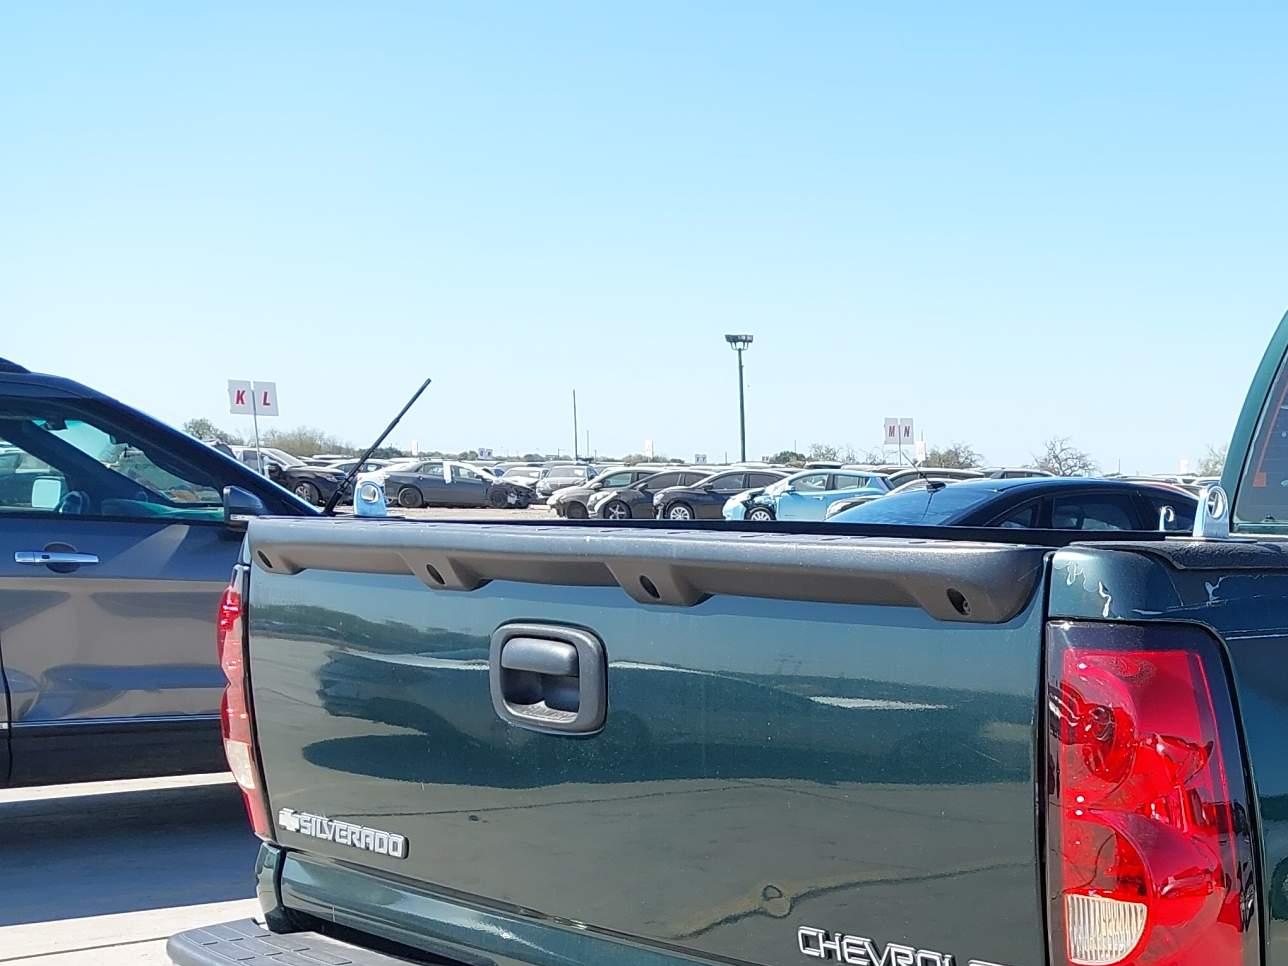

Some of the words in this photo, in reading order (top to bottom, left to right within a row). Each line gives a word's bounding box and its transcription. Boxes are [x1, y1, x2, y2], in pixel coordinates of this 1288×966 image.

[236, 390, 246, 405] K
[263, 391, 271, 406] L
[300, 813, 405, 859] SILVERADO
